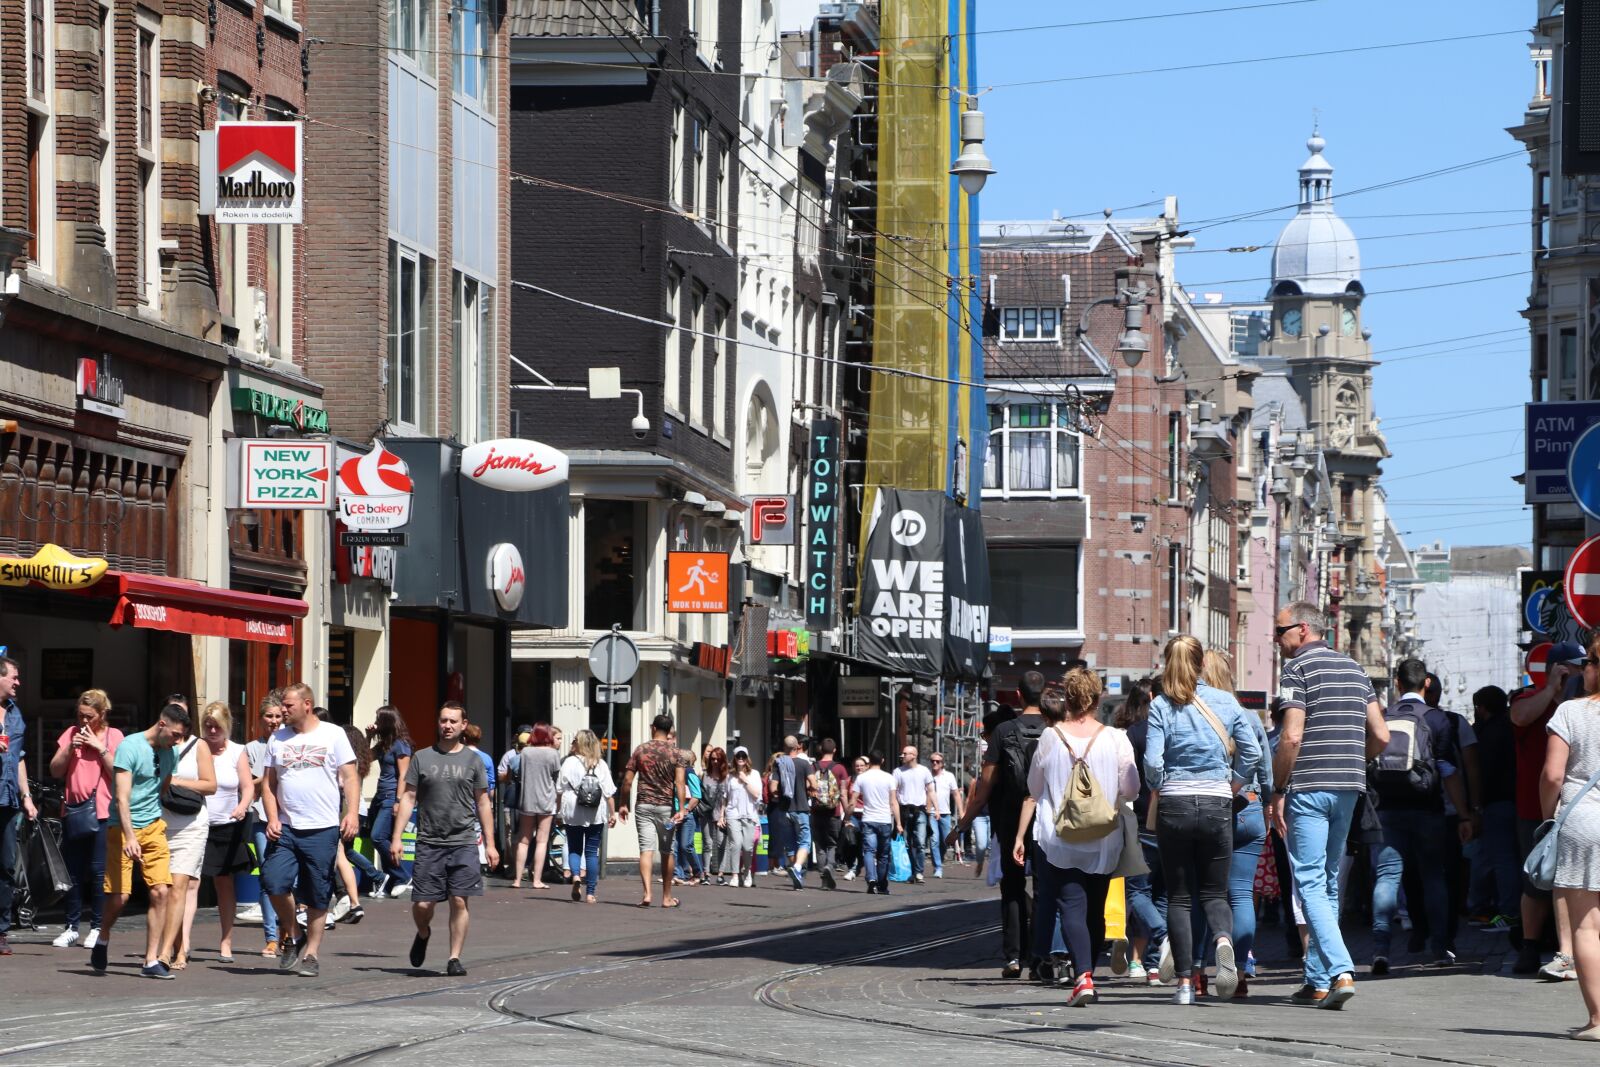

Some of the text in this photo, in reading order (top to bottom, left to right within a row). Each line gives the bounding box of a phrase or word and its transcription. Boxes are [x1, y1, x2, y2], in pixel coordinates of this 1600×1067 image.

[218, 170, 295, 198] Marlboro
[261, 211, 293, 219] dodelijk
[1535, 417, 1576, 432] ATM
[264, 450, 311, 462] NEW
[472, 447, 556, 478] jamin
[254, 467, 318, 483] YORK
[257, 486, 318, 498] PIZZA
[367, 503, 404, 515] bakery
[356, 516, 390, 525] COMPANY
[810, 436, 832, 614] TOPWATCH
[895, 518, 921, 537] JD
[871, 559, 944, 592] WE
[672, 601, 723, 609] WOK TO WALK
[870, 591, 943, 619] ARE
[871, 617, 942, 639] OPEN
